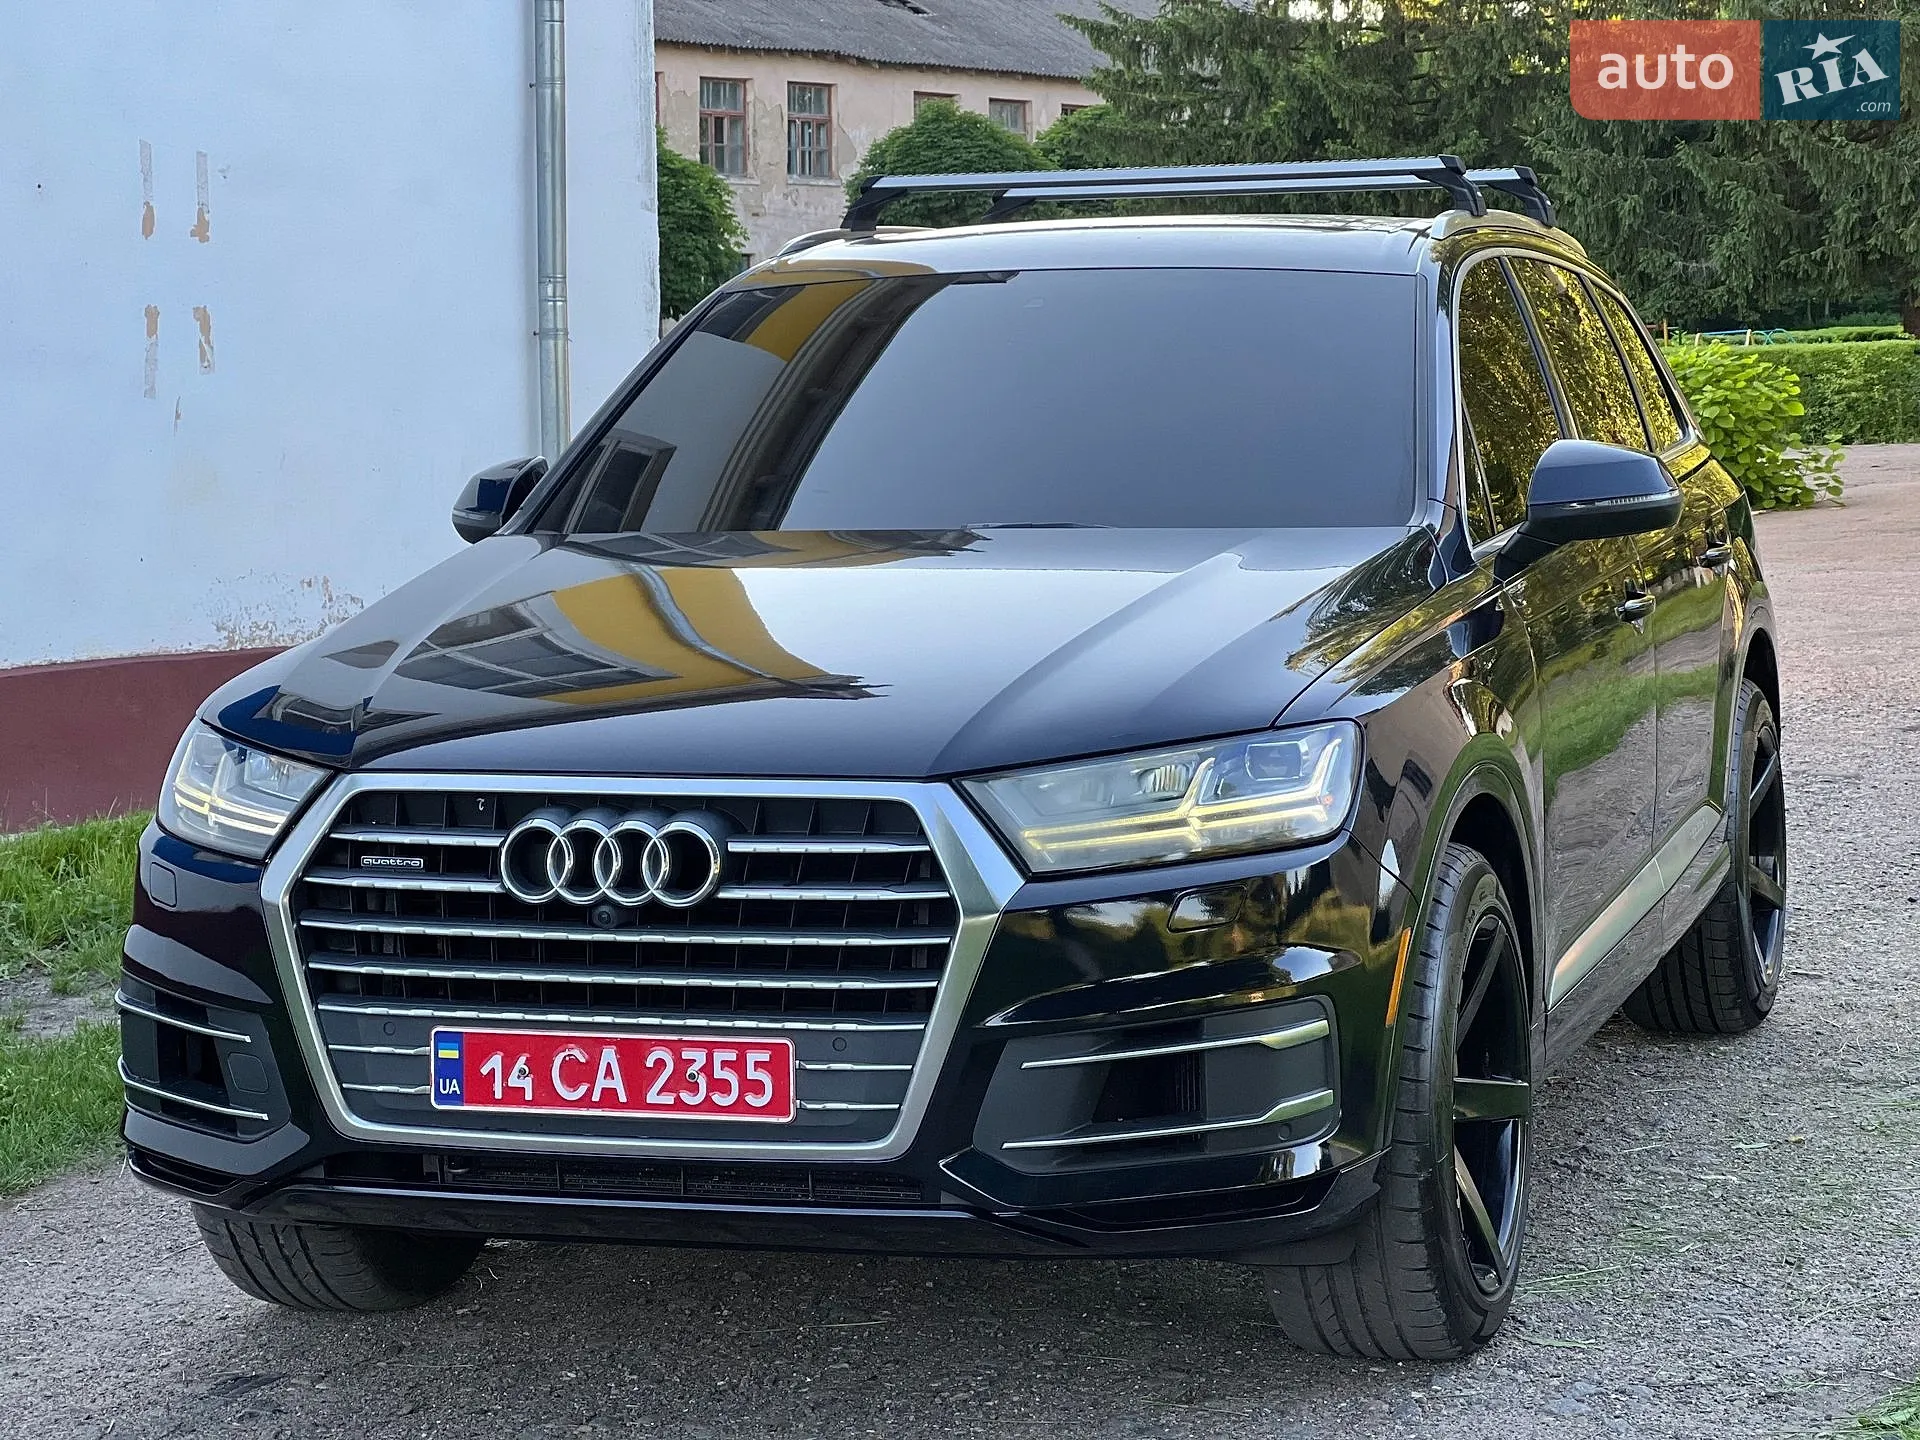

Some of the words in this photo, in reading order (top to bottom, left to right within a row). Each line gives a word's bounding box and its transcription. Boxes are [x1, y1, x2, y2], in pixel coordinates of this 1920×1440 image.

[363, 858, 420, 867] quattro
[479, 1051, 534, 1101] 14
[551, 1045, 628, 1103] CA
[645, 1047, 774, 1107] 2355
[439, 1078, 461, 1095] UA
